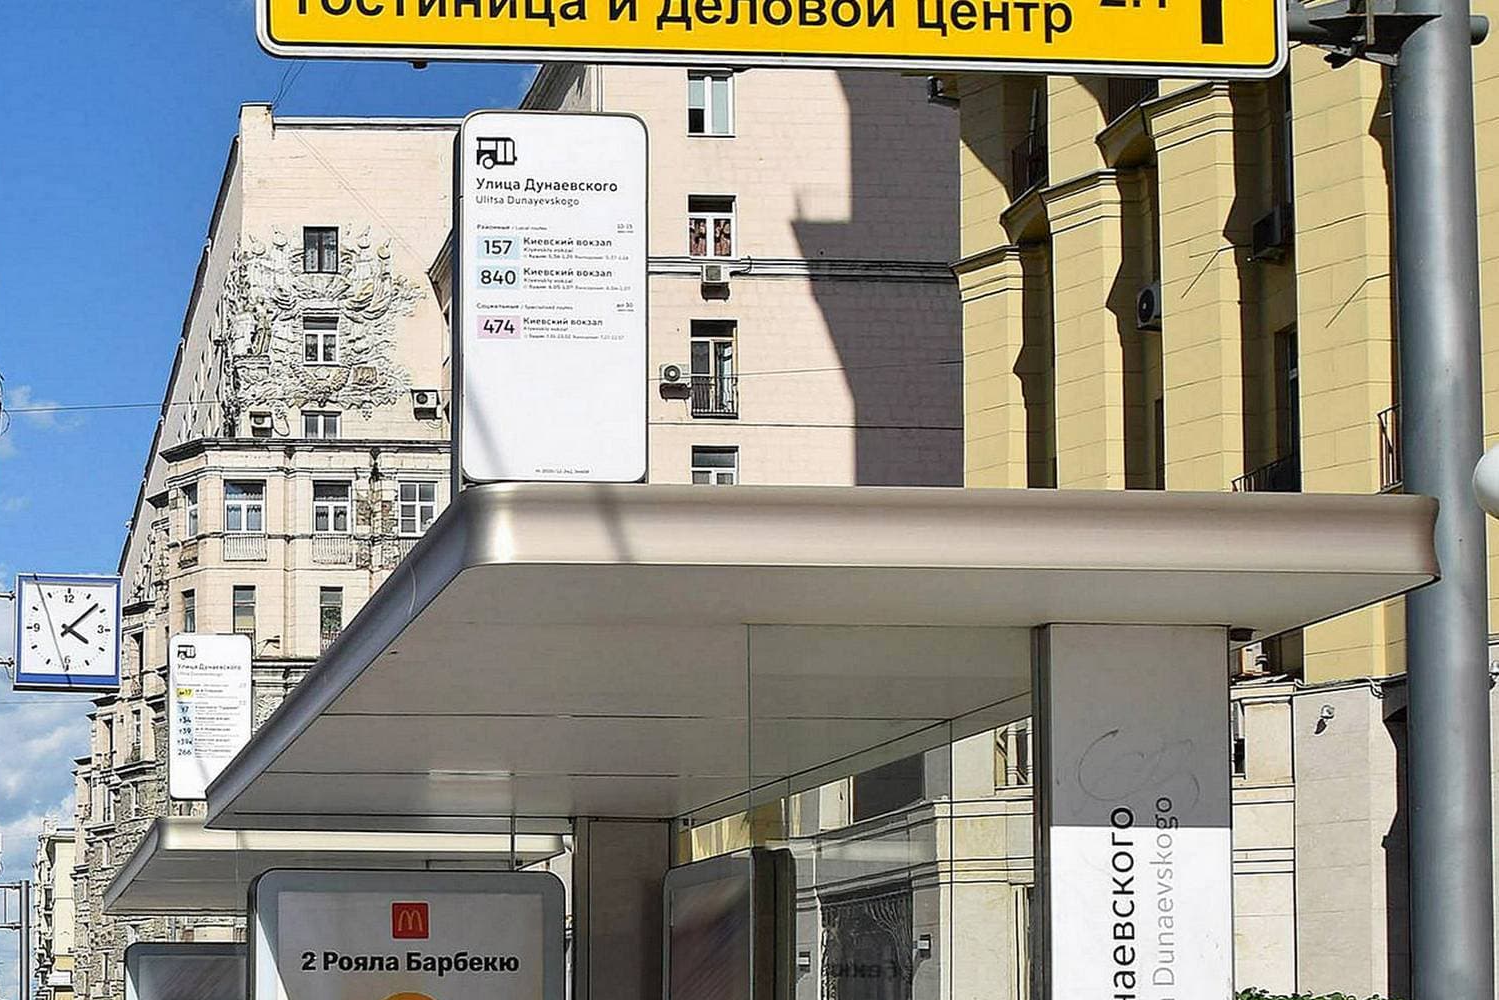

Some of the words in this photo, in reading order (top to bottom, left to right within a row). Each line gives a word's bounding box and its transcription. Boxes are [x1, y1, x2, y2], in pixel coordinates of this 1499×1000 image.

[917, 0, 1072, 44] центр
[476, 178, 520, 191] Улица
[524, 178, 618, 193] Дунаевского
[476, 195, 504, 205] Ulitsa
[507, 196, 580, 208] Dunayevskogo
[484, 240, 513, 255] 157
[523, 237, 574, 247] Киевский
[576, 239, 612, 247] вокзал
[481, 270, 517, 285] 840
[523, 267, 574, 277] Киевский
[576, 269, 612, 277] вокзал
[483, 320, 515, 334] 474
[523, 317, 569, 325] Киевский
[570, 318, 603, 326] вокзал
[64, 594, 74, 603] 12
[33, 623, 40, 632] 9
[97, 624, 104, 634] 3
[64, 655, 71, 664] 6
[1149, 797, 1179, 987] Dunaevskogo
[301, 952, 317, 971] 2
[323, 952, 399, 972] Рояла
[406, 952, 519, 977] Барбекю
